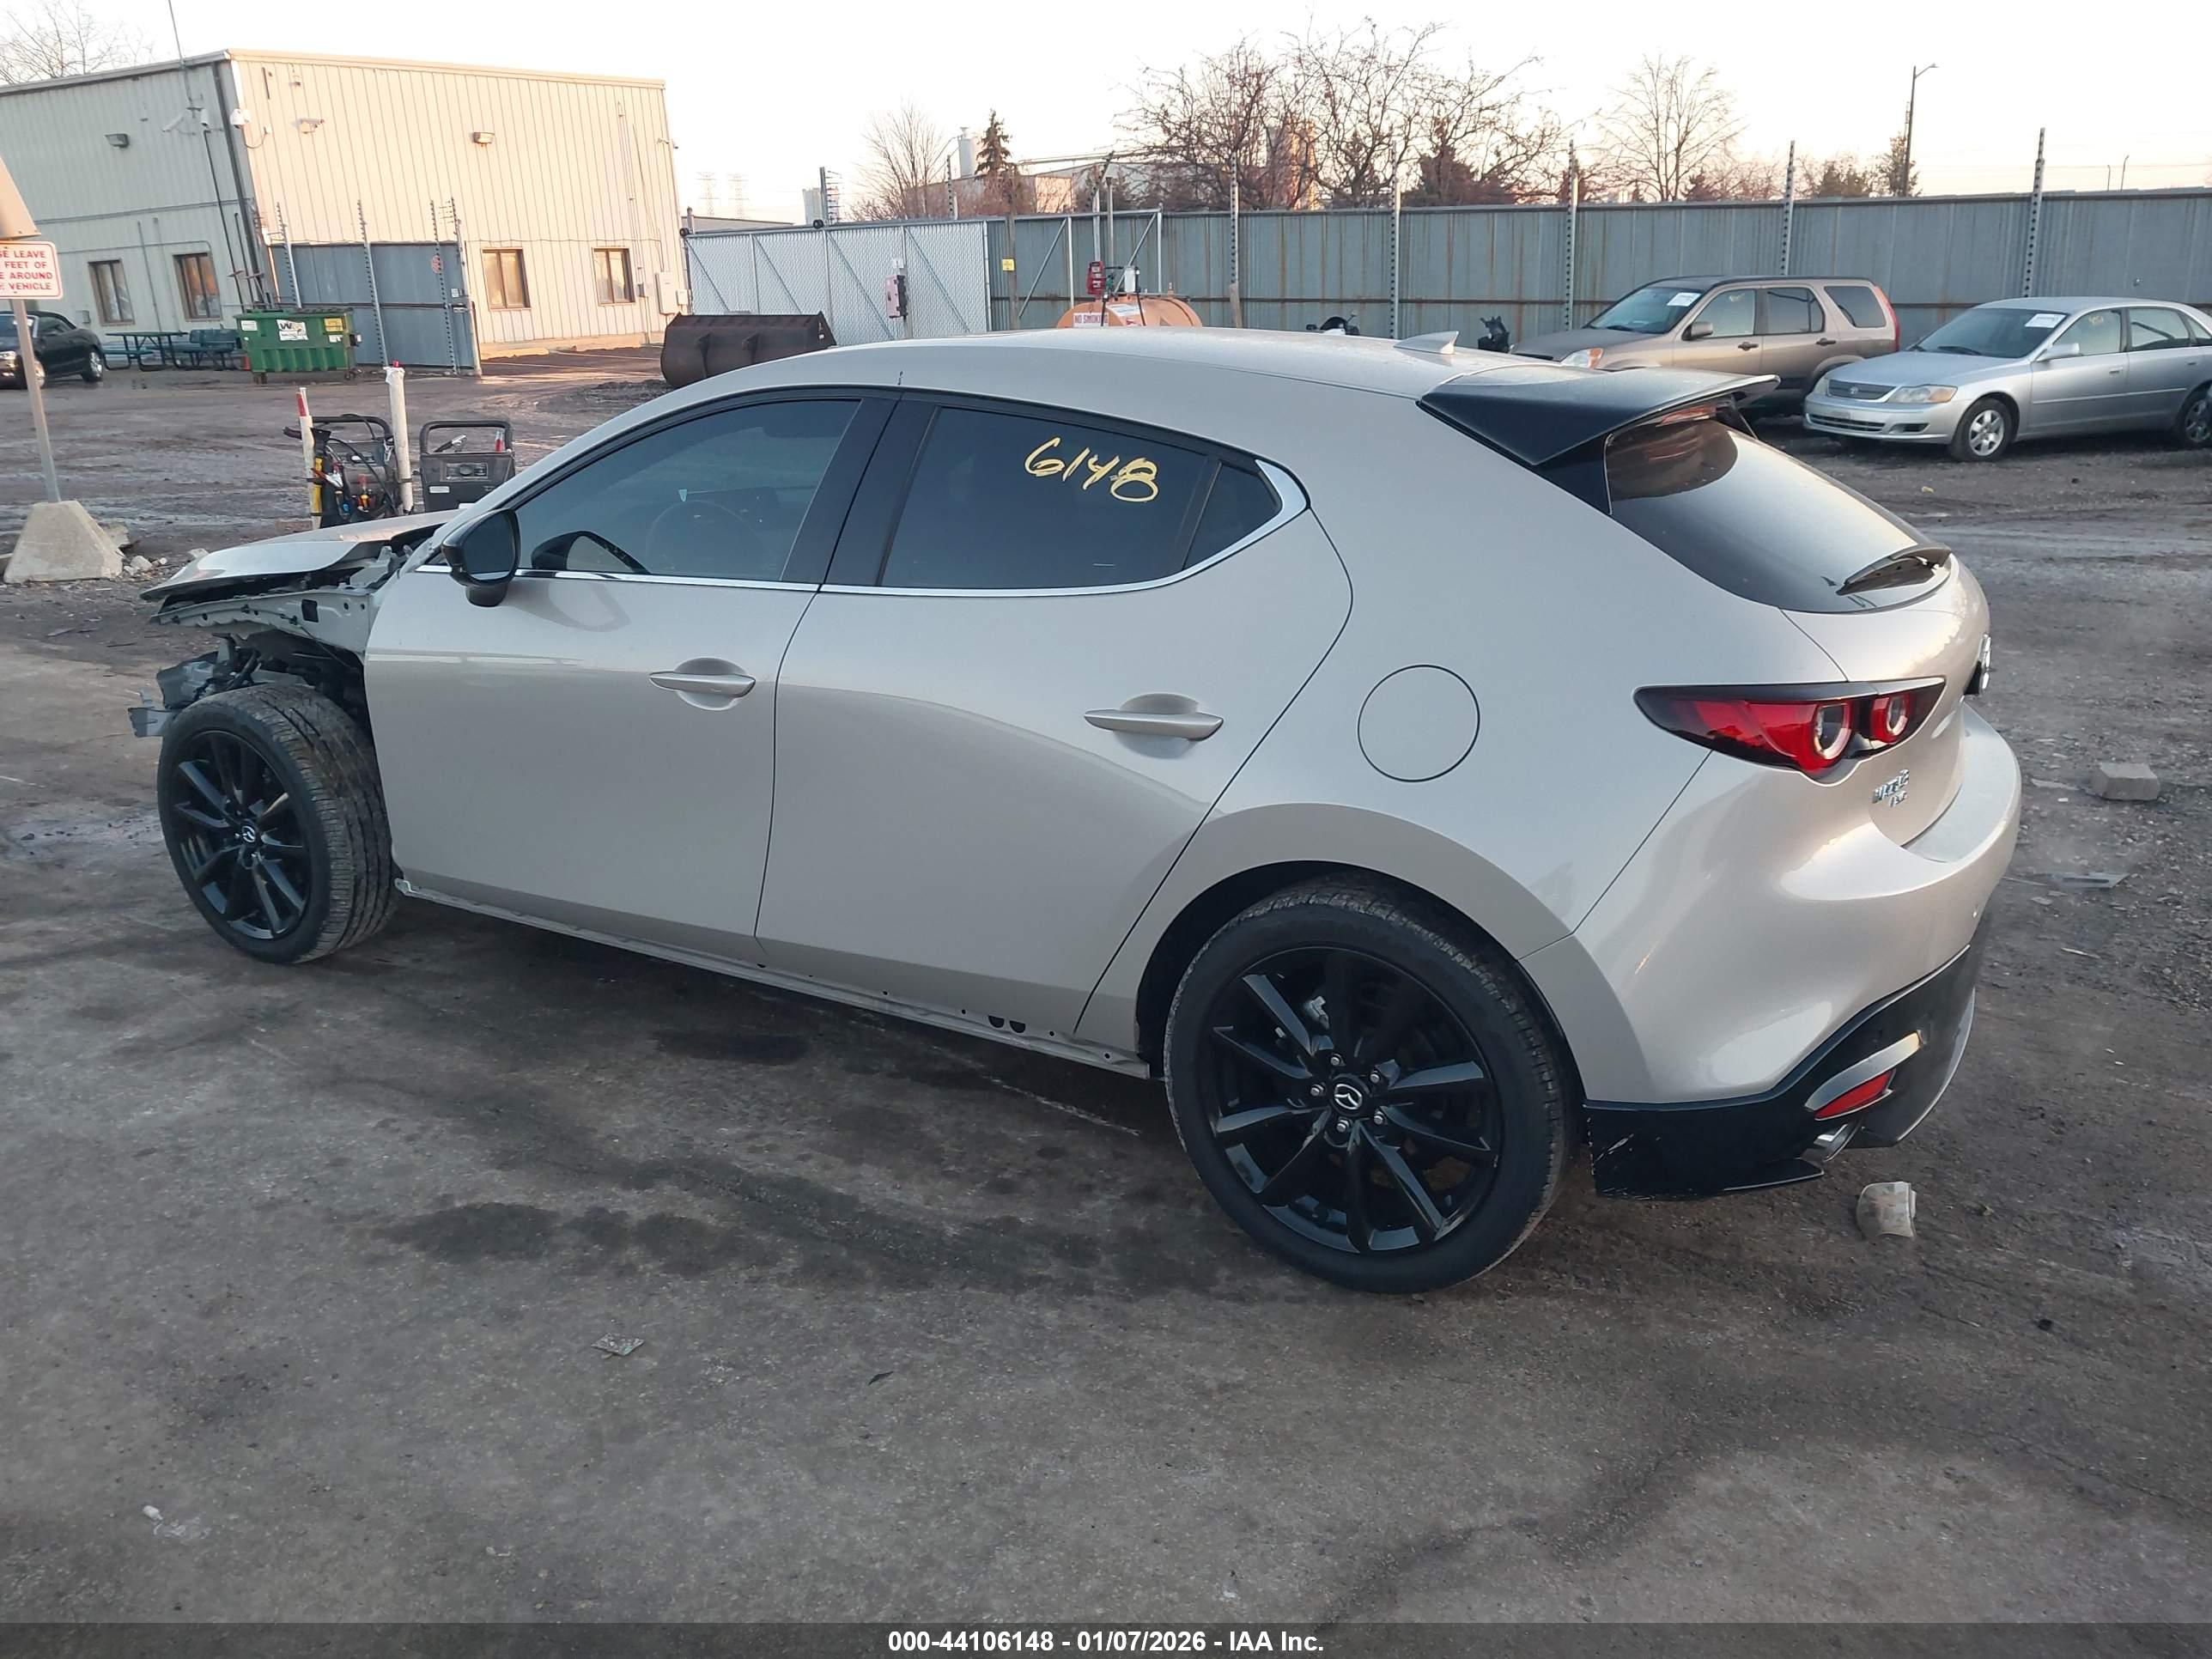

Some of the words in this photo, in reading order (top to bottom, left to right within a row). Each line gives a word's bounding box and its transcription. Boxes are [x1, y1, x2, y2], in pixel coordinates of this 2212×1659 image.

[14, 250, 46, 258] LEAVE
[9, 282, 52, 290] VEHICLE
[1024, 437, 1158, 502] 6148
